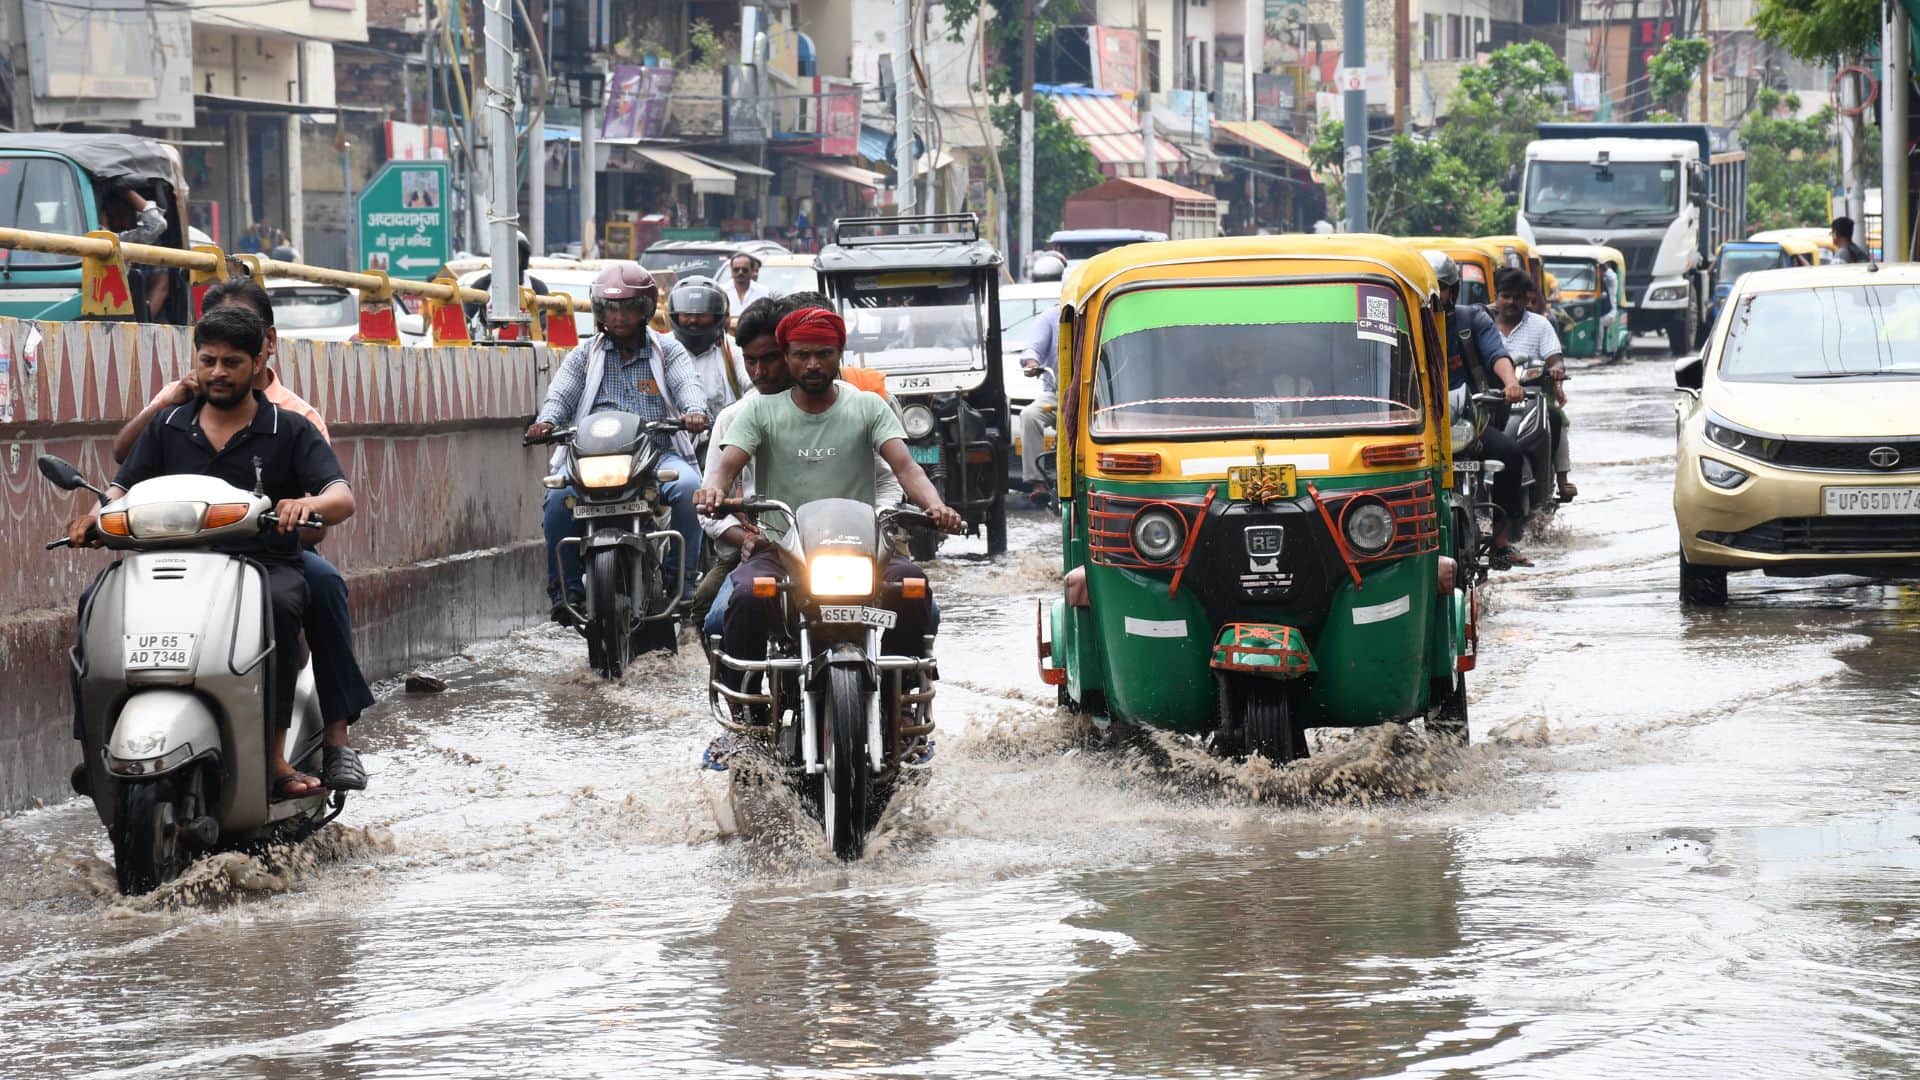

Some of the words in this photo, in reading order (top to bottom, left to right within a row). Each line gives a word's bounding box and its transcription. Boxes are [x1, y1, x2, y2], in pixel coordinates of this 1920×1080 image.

[1359, 320, 1373, 328] CP
[899, 377, 930, 388] JSA
[798, 448, 836, 457] NYC
[1253, 536, 1277, 550] RE
[862, 610, 893, 627] 9441
[139, 636, 158, 648] UP
[162, 636, 178, 648] 65
[129, 651, 148, 664] AD
[154, 651, 186, 663] 7348
